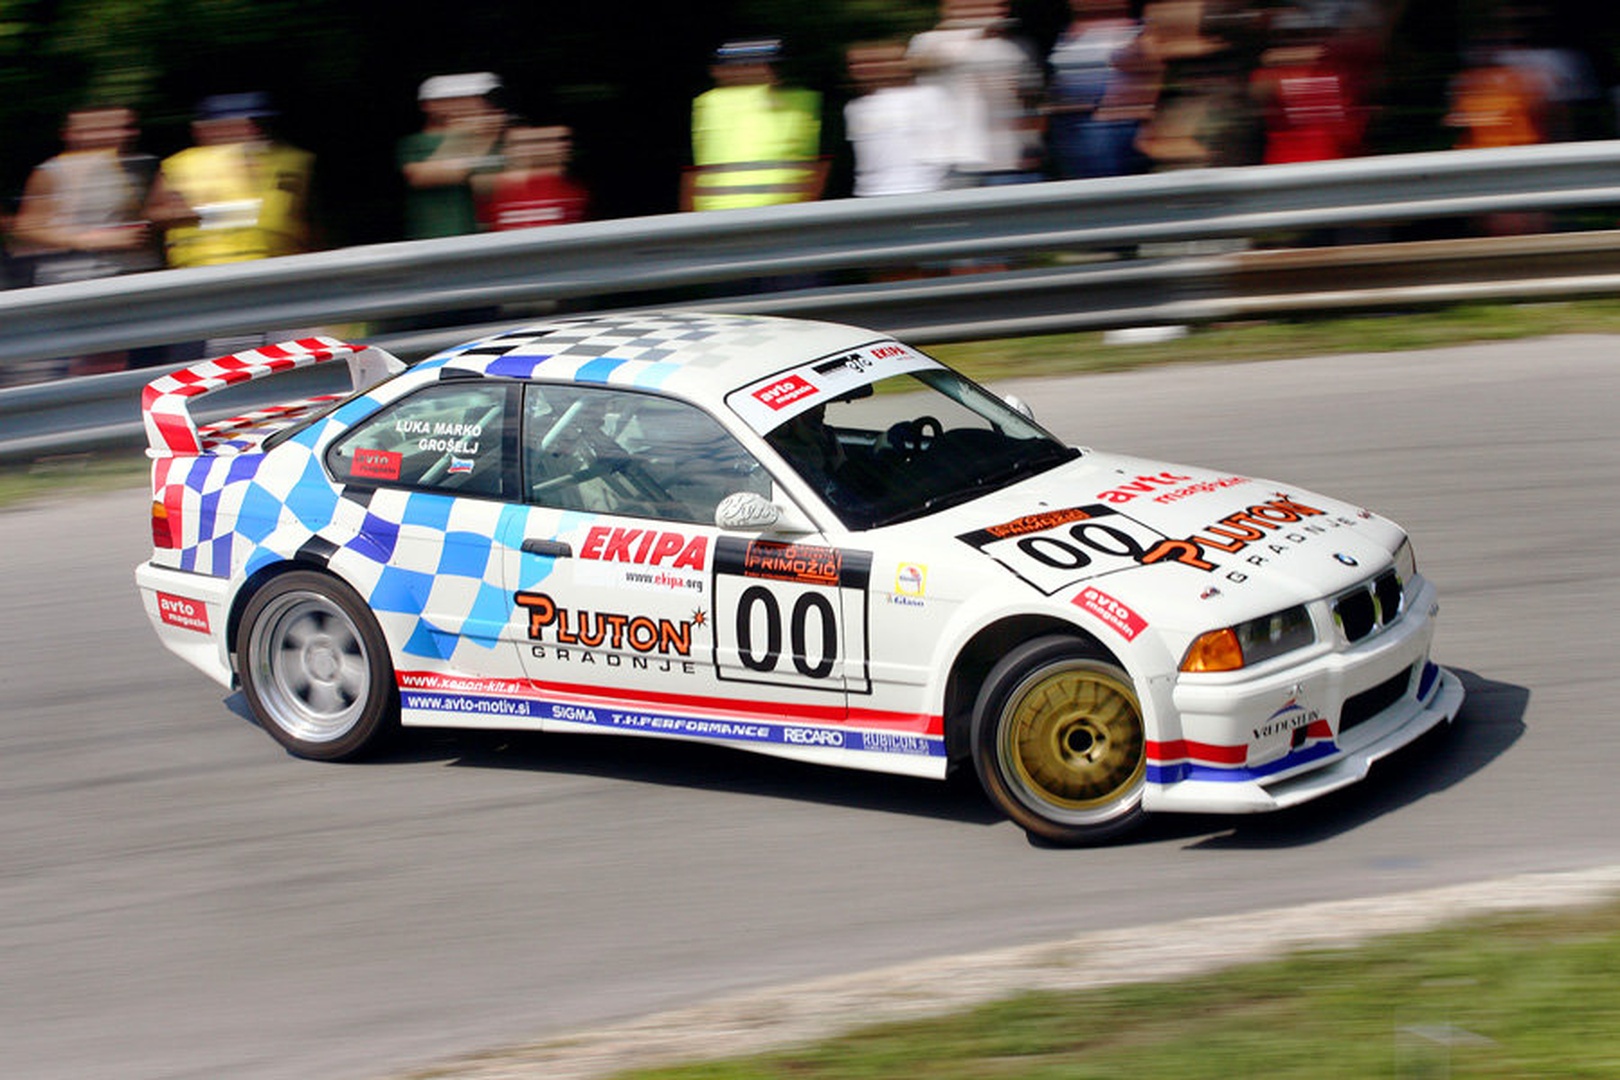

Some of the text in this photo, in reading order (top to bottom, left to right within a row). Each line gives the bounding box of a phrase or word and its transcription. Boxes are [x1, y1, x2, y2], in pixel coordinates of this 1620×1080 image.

[760, 381, 795, 400] avto
[395, 420, 482, 437] LUKA MARKO
[418, 436, 480, 454] GROŠELJ
[1133, 497, 1327, 573] PLUTON
[579, 526, 709, 571] EKIPA
[1016, 523, 1145, 570] 00
[625, 570, 704, 592] www.ekipa.org
[160, 598, 195, 616] avto
[1083, 589, 1129, 619] avto
[513, 590, 692, 656] PLUTON
[736, 585, 837, 679] 00
[532, 645, 696, 674] GRADNJE
[402, 674, 520, 694] www.xenon-kit.si
[407, 696, 531, 716] www.avto-motiv.si
[551, 705, 597, 723] SIGMA
[783, 726, 843, 746] RECARO
[862, 731, 918, 750] RUBICON
